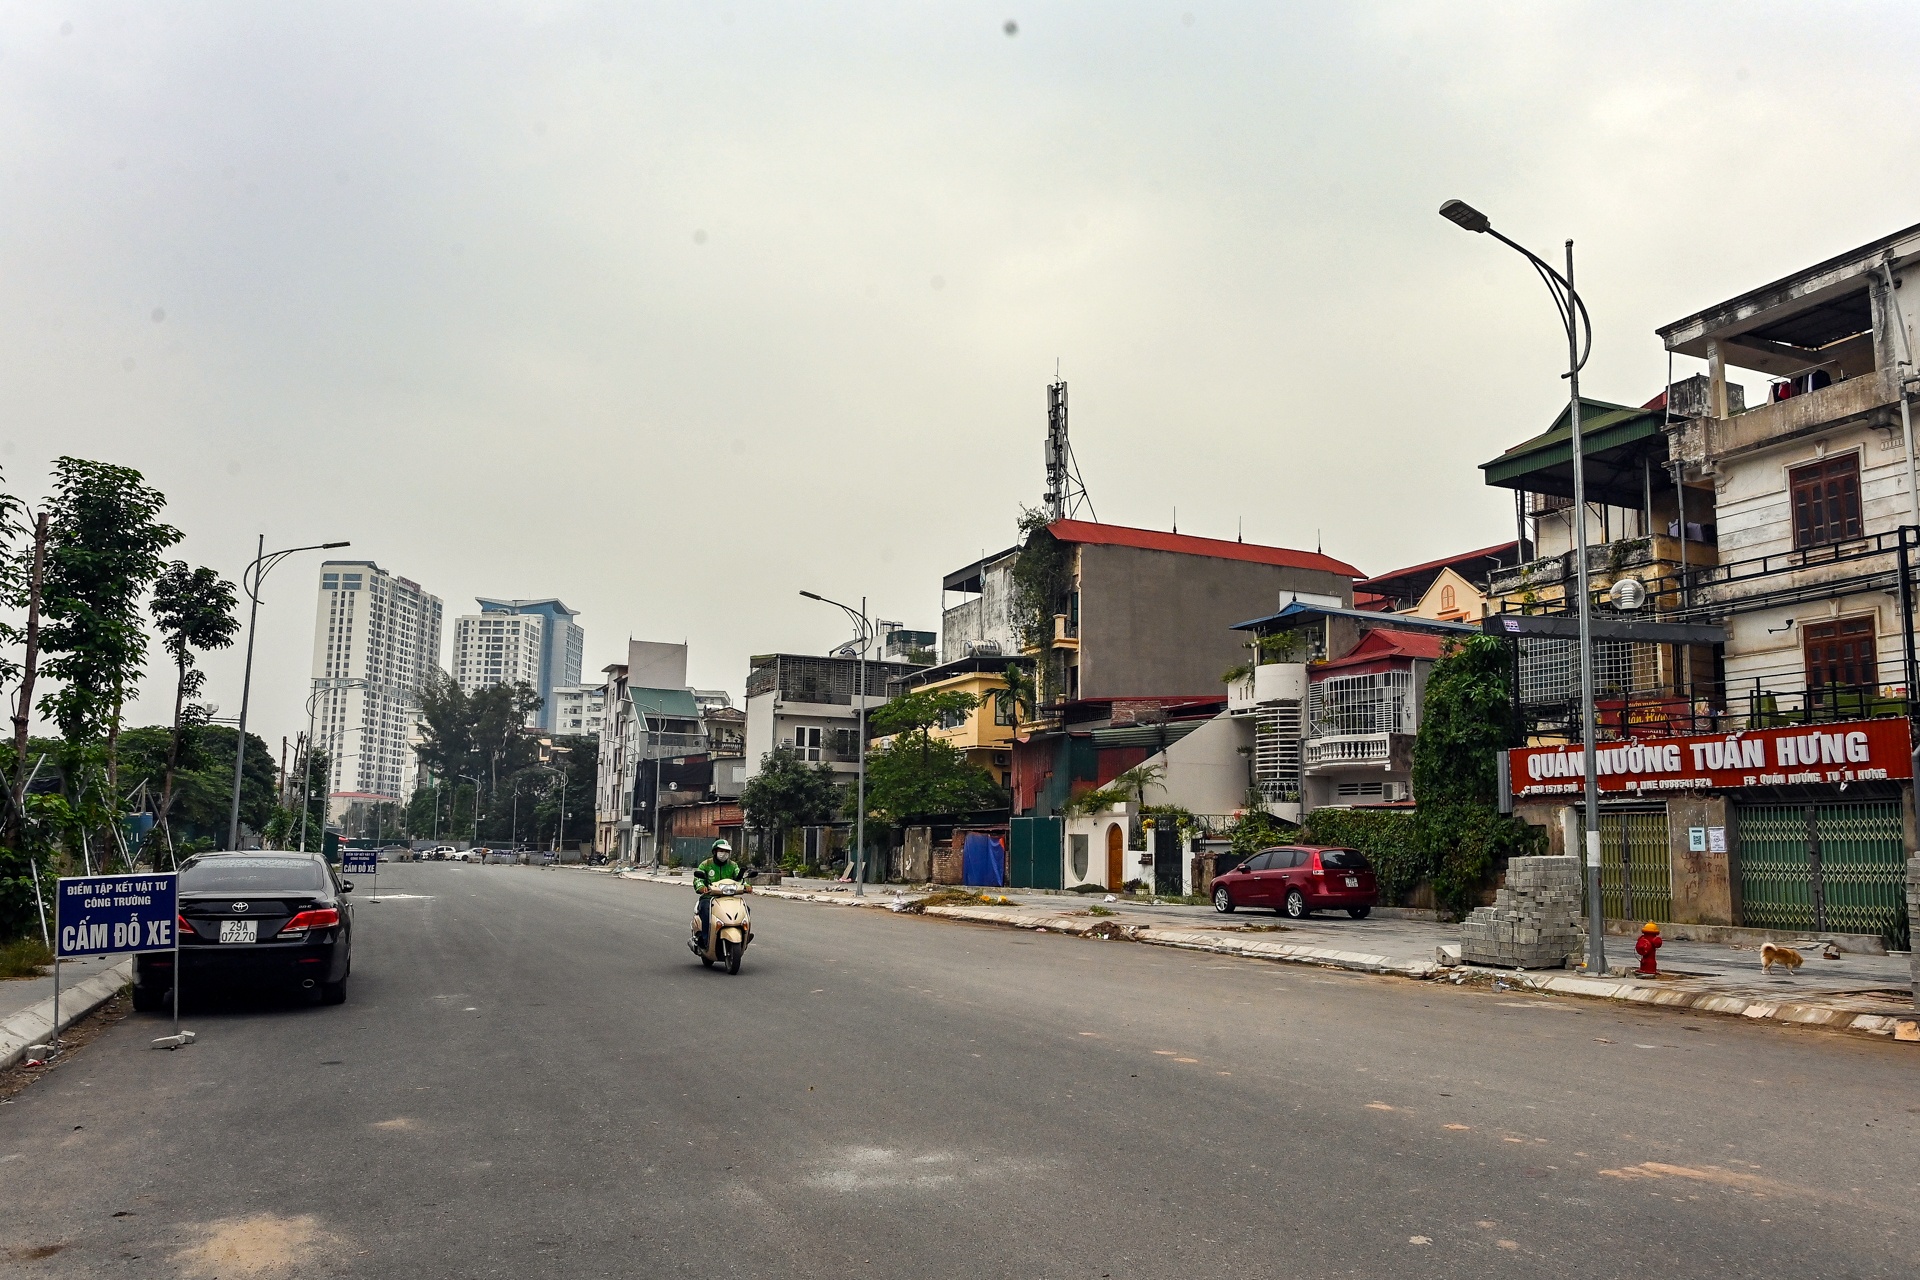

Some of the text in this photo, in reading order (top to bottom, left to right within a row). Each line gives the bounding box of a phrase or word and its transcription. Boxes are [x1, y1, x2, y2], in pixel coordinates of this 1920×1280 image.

[1690, 731, 1765, 771] TUẤN
[1776, 731, 1870, 766] HƯNG
[67, 880, 168, 895] ĐIỂM TẬP KẾT VẬT TƯ
[84, 894, 151, 908] CÔNG TRƯỜNG
[62, 912, 171, 952] CẤM ĐỖ XE
[229, 921, 248, 932] 29A
